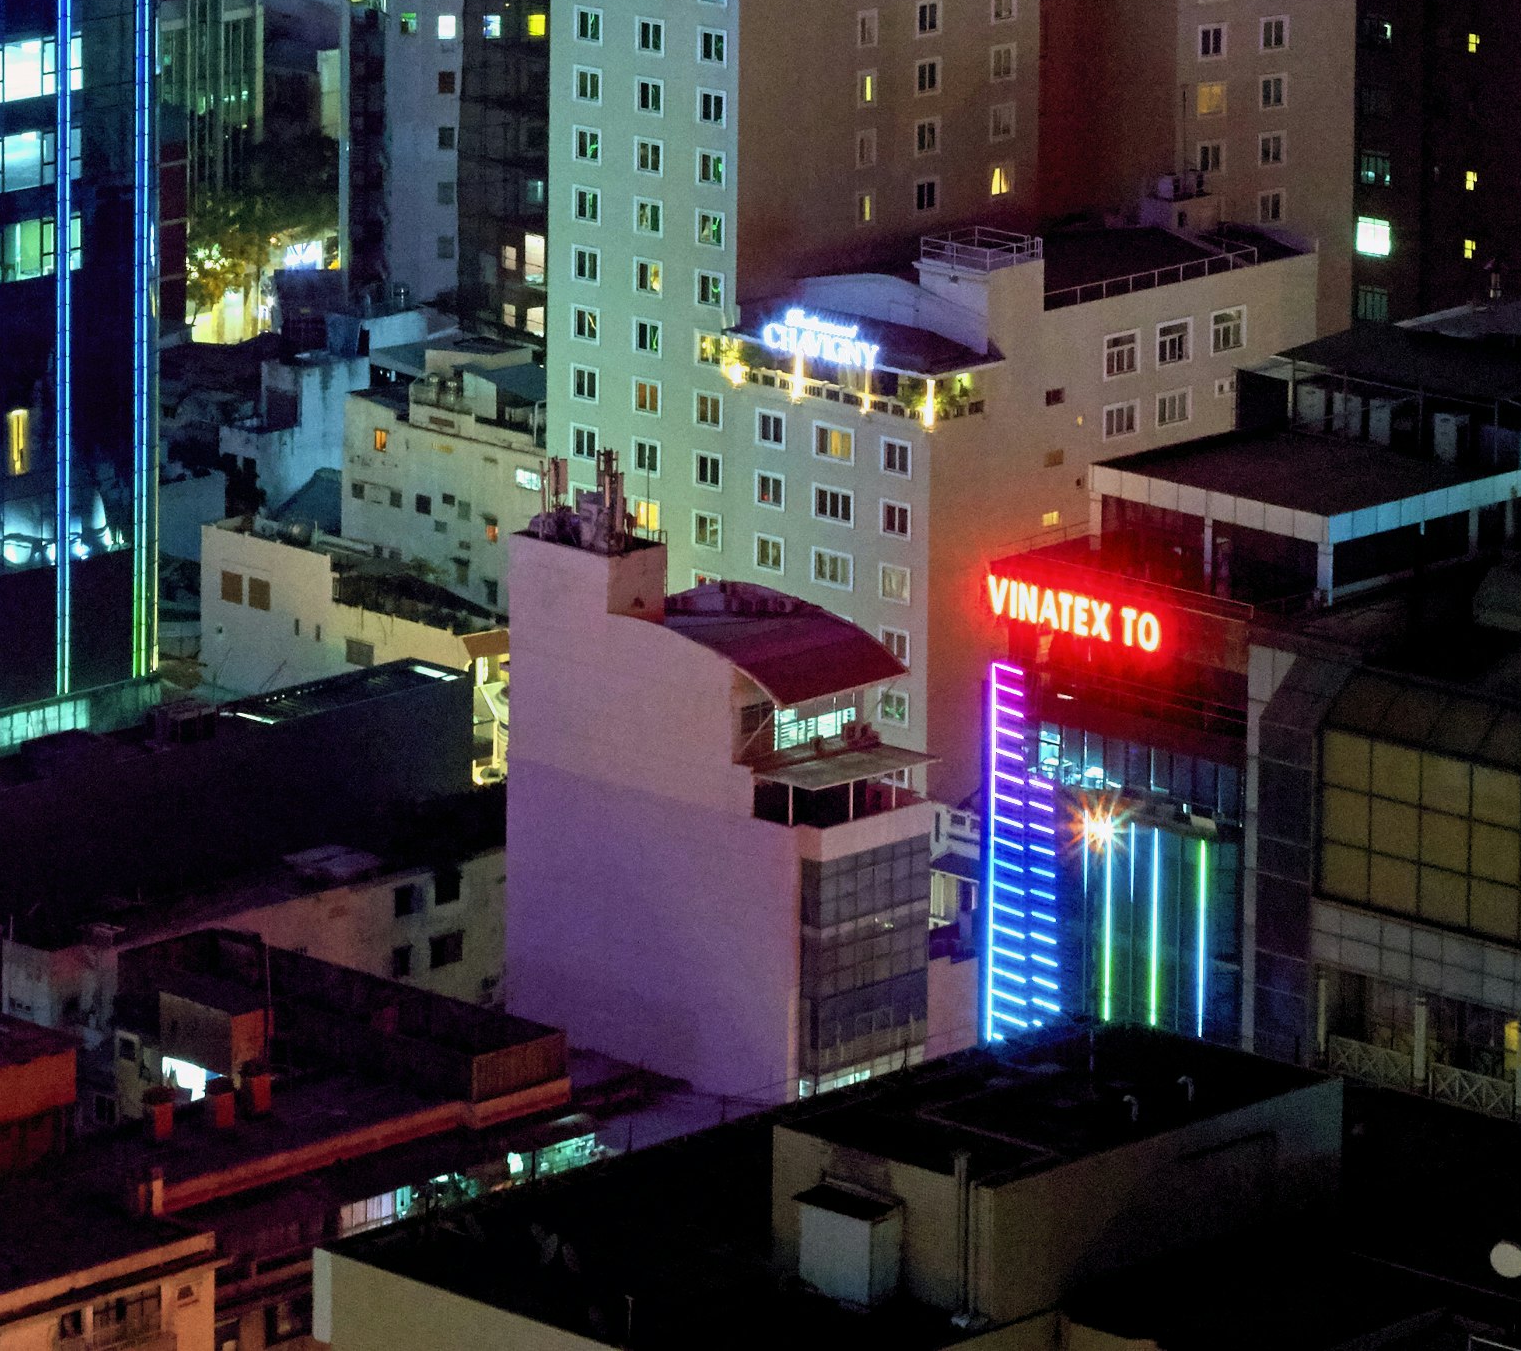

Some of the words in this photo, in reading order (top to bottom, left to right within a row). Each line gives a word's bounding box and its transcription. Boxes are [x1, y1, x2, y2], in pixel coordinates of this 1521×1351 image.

[763, 323, 880, 370] CHAVIGNY
[988, 575, 1111, 642] VINATEX
[1121, 607, 1161, 652] TO
